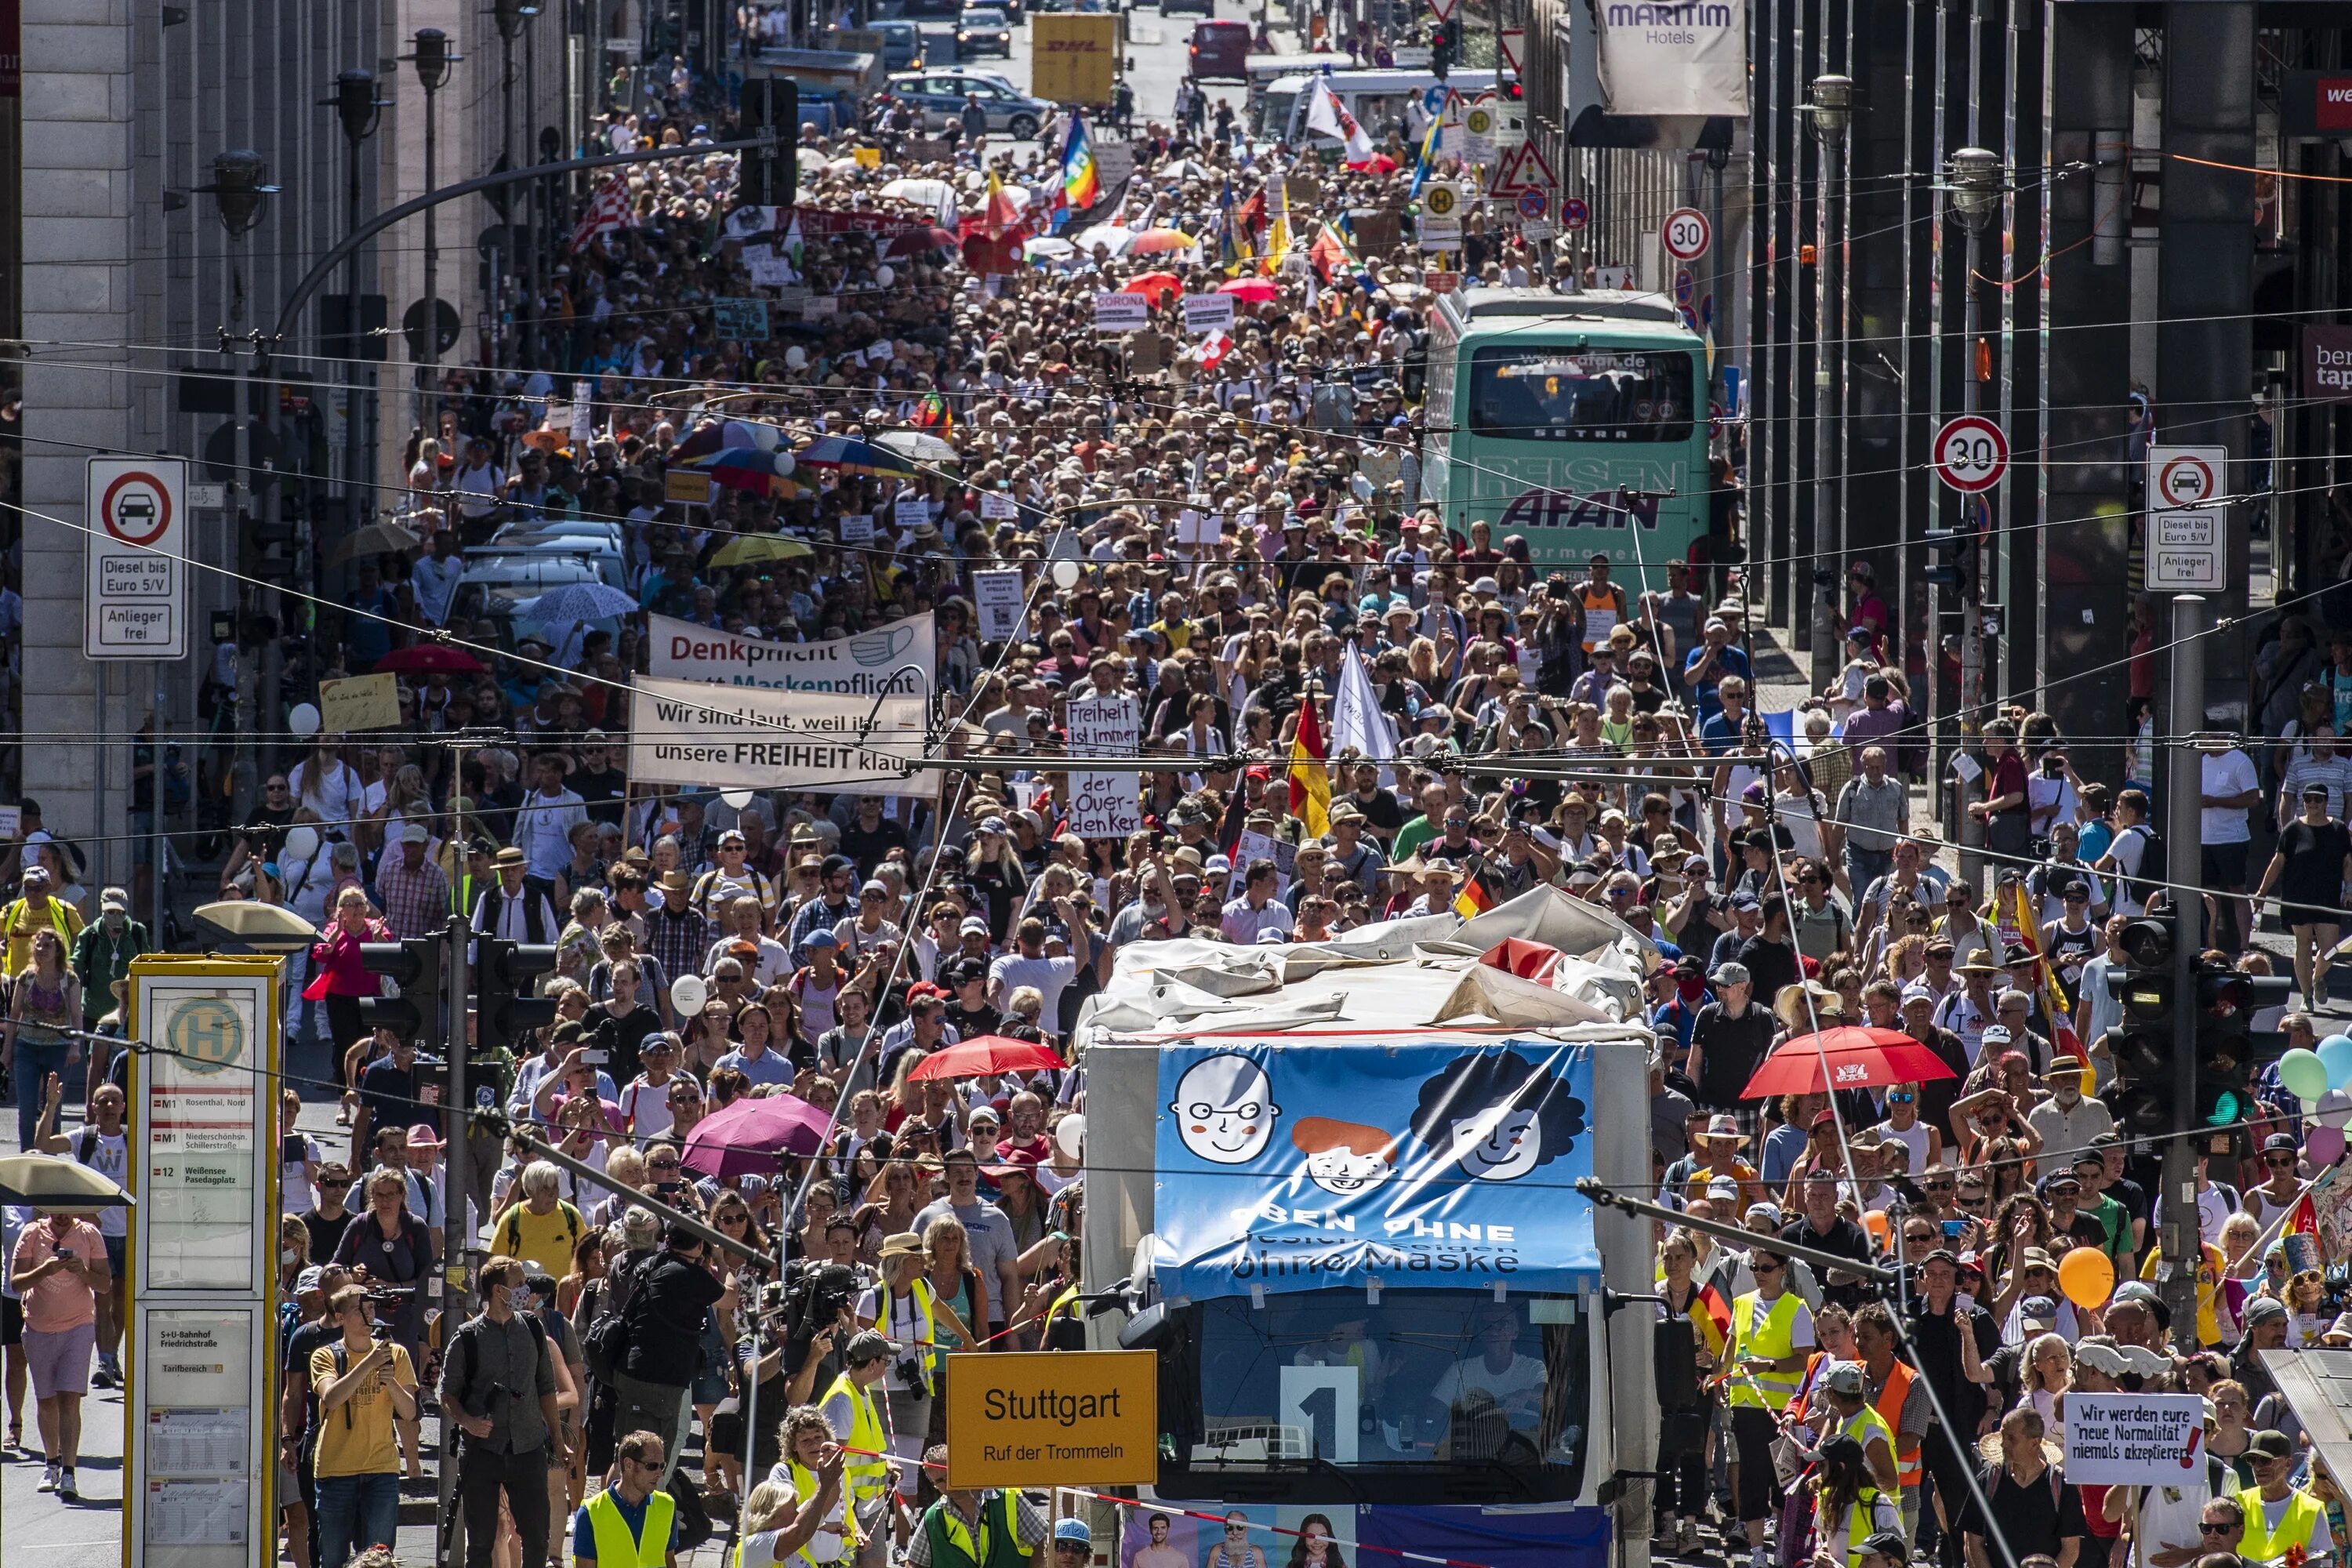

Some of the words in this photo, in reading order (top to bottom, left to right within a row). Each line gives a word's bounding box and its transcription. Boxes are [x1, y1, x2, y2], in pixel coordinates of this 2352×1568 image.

[1608, 4, 1730, 27] MARITIM
[1646, 31, 1695, 44] Hotels
[1673, 223, 1700, 245] 30
[1098, 296, 1145, 308] CORONA
[1534, 429, 1628, 439] SETRA
[1951, 437, 1992, 470] 30
[1473, 452, 1686, 496] REISEN
[1497, 486, 1661, 531] AFAN
[2164, 521, 2192, 529] Diesel
[2195, 521, 2209, 529] bis
[2165, 532, 2187, 541] Euro
[2190, 532, 2207, 542] 5/V
[105, 561, 143, 573] Diesel
[148, 561, 166, 573] bis
[2164, 557, 2208, 568] Anlieger
[2177, 568, 2194, 577] frei
[107, 579, 137, 591] Euro
[143, 579, 165, 592] 5/V
[107, 610, 164, 625] Anlieger
[125, 626, 147, 639] frei
[657, 703, 693, 723] Wir
[698, 707, 743, 726] sind
[750, 710, 796, 730] laut,
[802, 715, 846, 731] weil
[1066, 701, 1131, 724] Freiheit
[1071, 727, 1088, 746] ist
[1093, 728, 1137, 747] immer
[655, 746, 728, 763] unsere
[735, 743, 855, 769] FREIHEIT
[859, 748, 906, 771] klau
[1083, 772, 1115, 792] der
[2061, 942, 2085, 952] NIKE
[187, 1015, 223, 1056] H
[162, 1099, 176, 1109] M1
[185, 1098, 225, 1107] Rosenthal,
[162, 1134, 176, 1142] M1
[185, 1132, 248, 1141] Niederschönhsn.
[162, 1167, 174, 1177] 12
[185, 1167, 227, 1175] Weißensee
[185, 1176, 236, 1185] Pasedagplatz
[1230, 1250, 1346, 1279] ohne
[1365, 1247, 1519, 1274] Maske
[161, 1330, 211, 1339] S+U-Bahnhof
[163, 1364, 207, 1373] Tarifbereich
[985, 1387, 1121, 1427] Stuttgart
[2080, 1403, 2105, 1422] Wir
[2108, 1404, 2158, 1423] werden
[2162, 1410, 2190, 1423] eure
[1298, 1387, 1336, 1459] 1
[984, 1445, 1012, 1462] Ruf
[1015, 1445, 1041, 1461] der
[1045, 1443, 1123, 1461] Trommeln
[2072, 1443, 2119, 1459] niemals
[2125, 1443, 2190, 1466] akzeptieren
